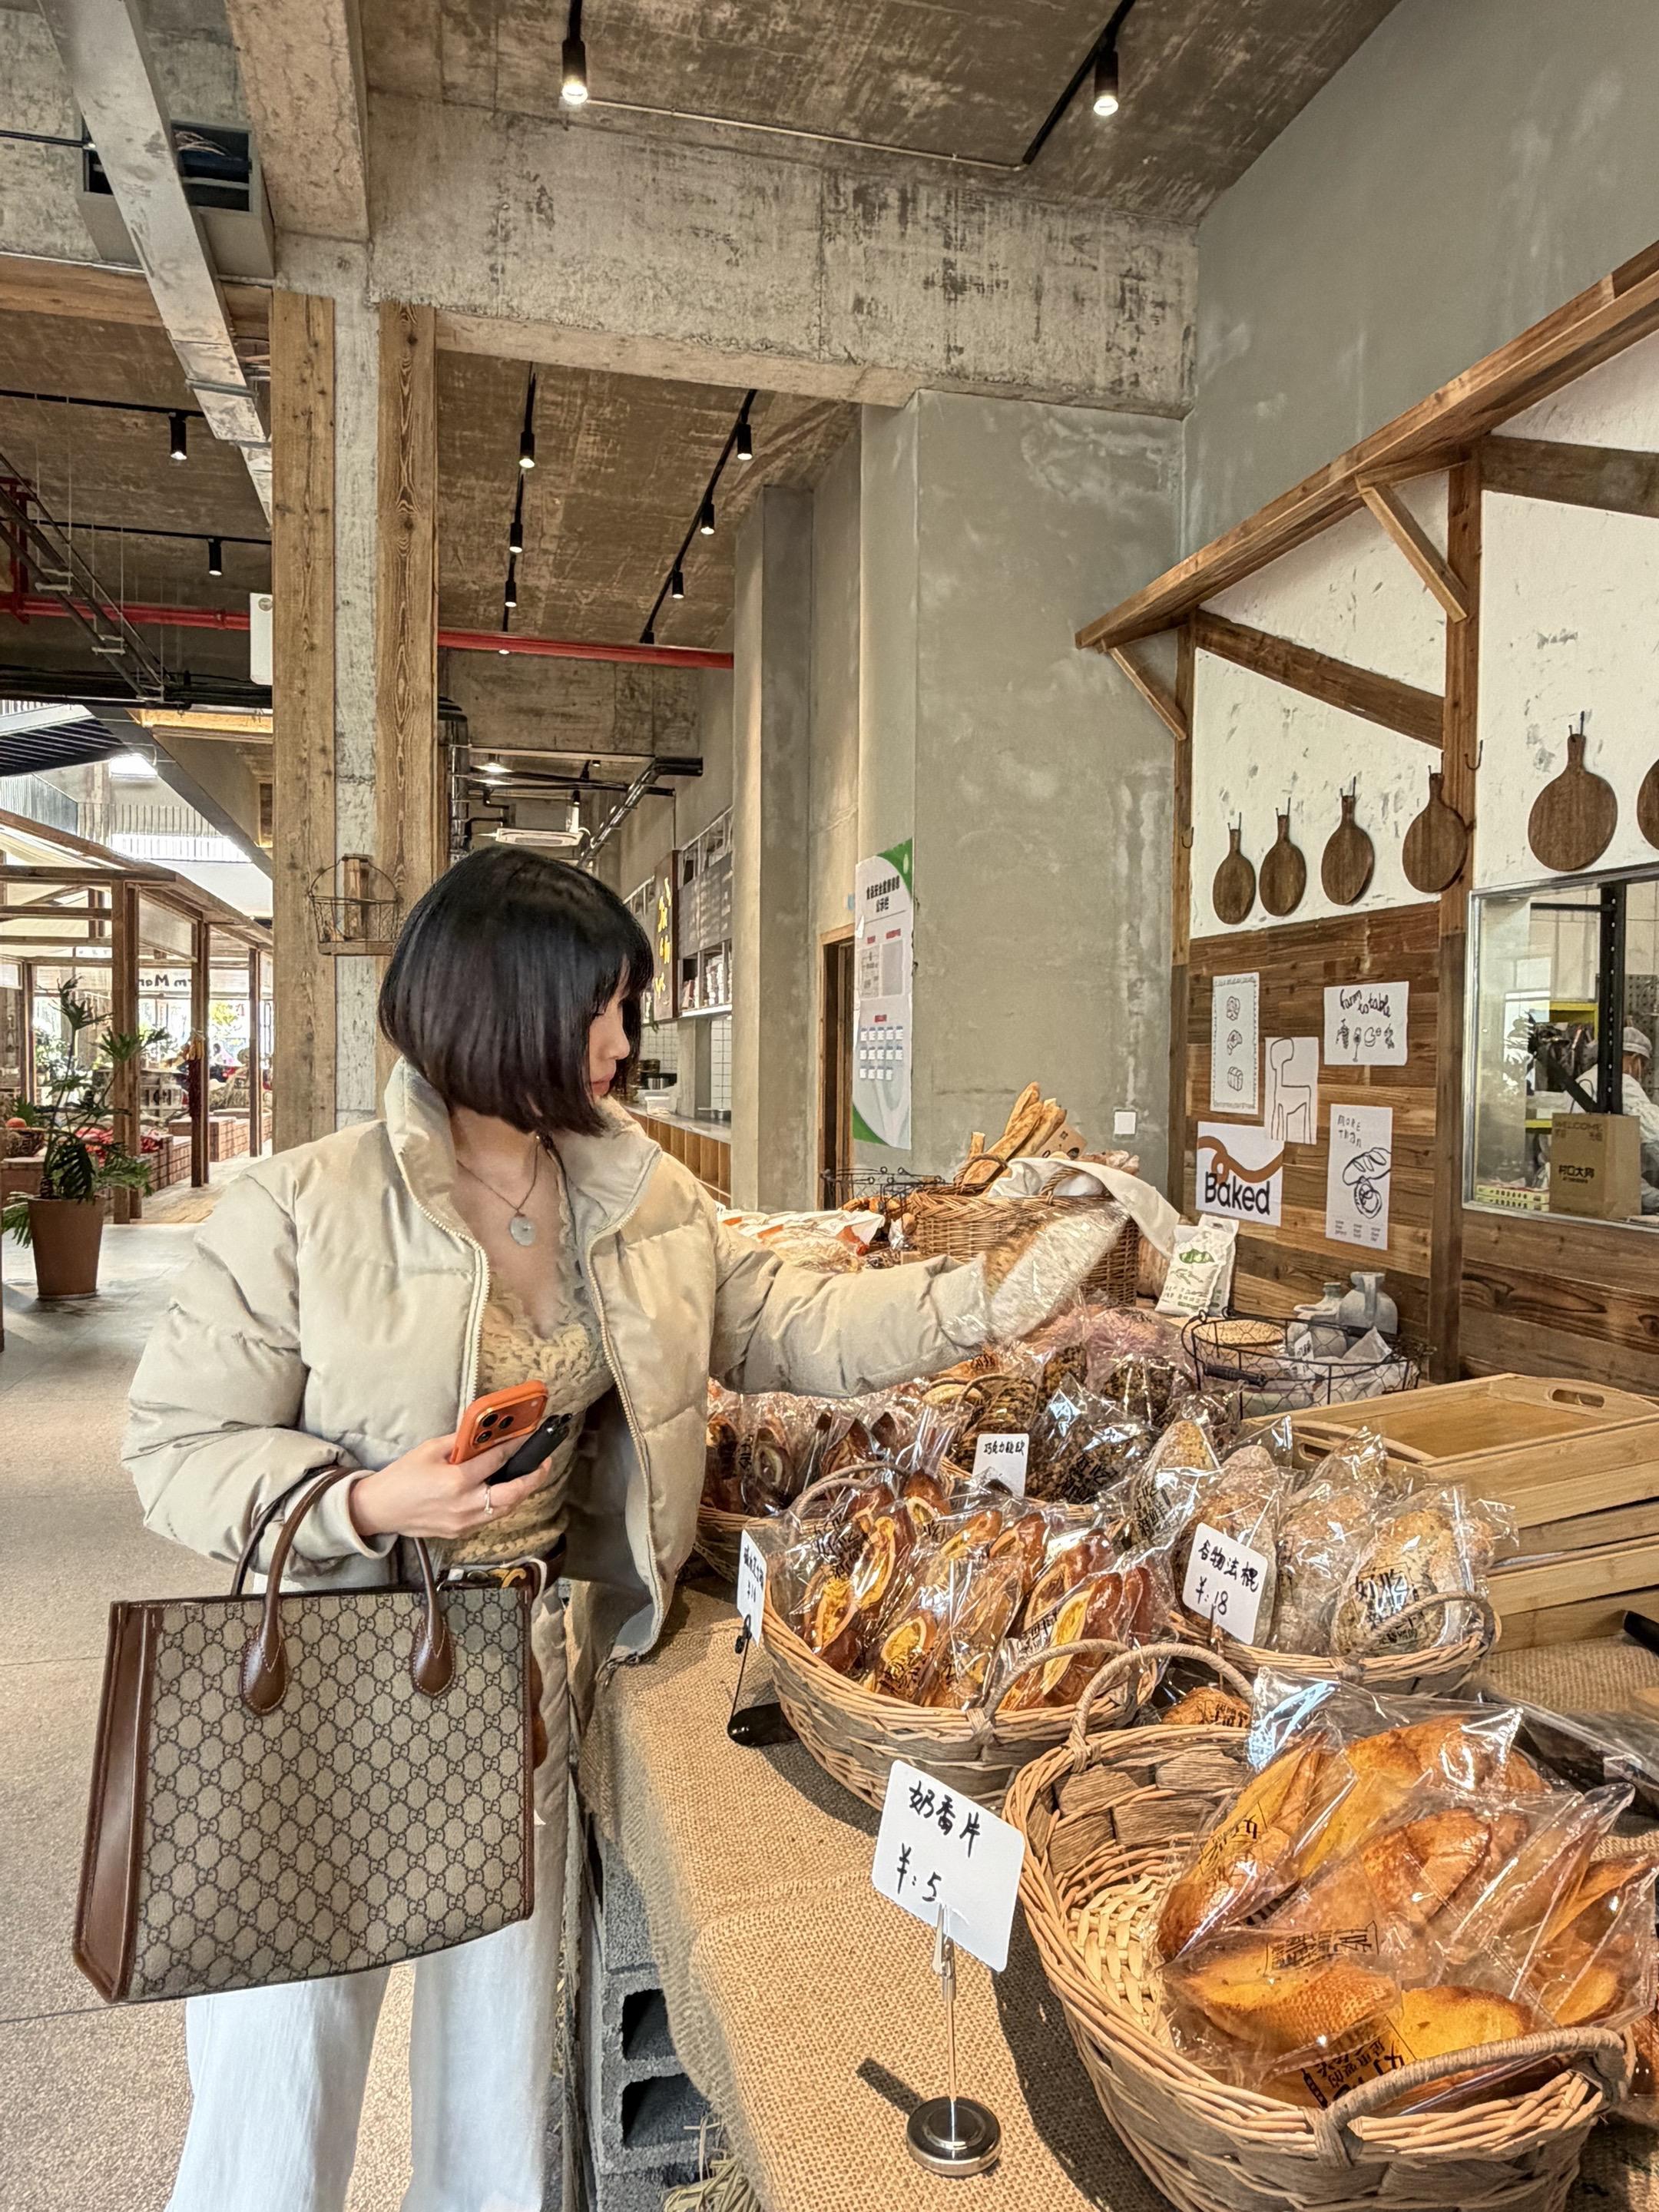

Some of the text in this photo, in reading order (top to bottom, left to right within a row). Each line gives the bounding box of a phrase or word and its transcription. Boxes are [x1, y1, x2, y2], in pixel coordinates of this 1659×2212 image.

[1204, 1171, 1270, 1215] Baked
[1198, 1539, 1259, 1592] 谷物法棍
[909, 1780, 980, 1859] 奶香片
